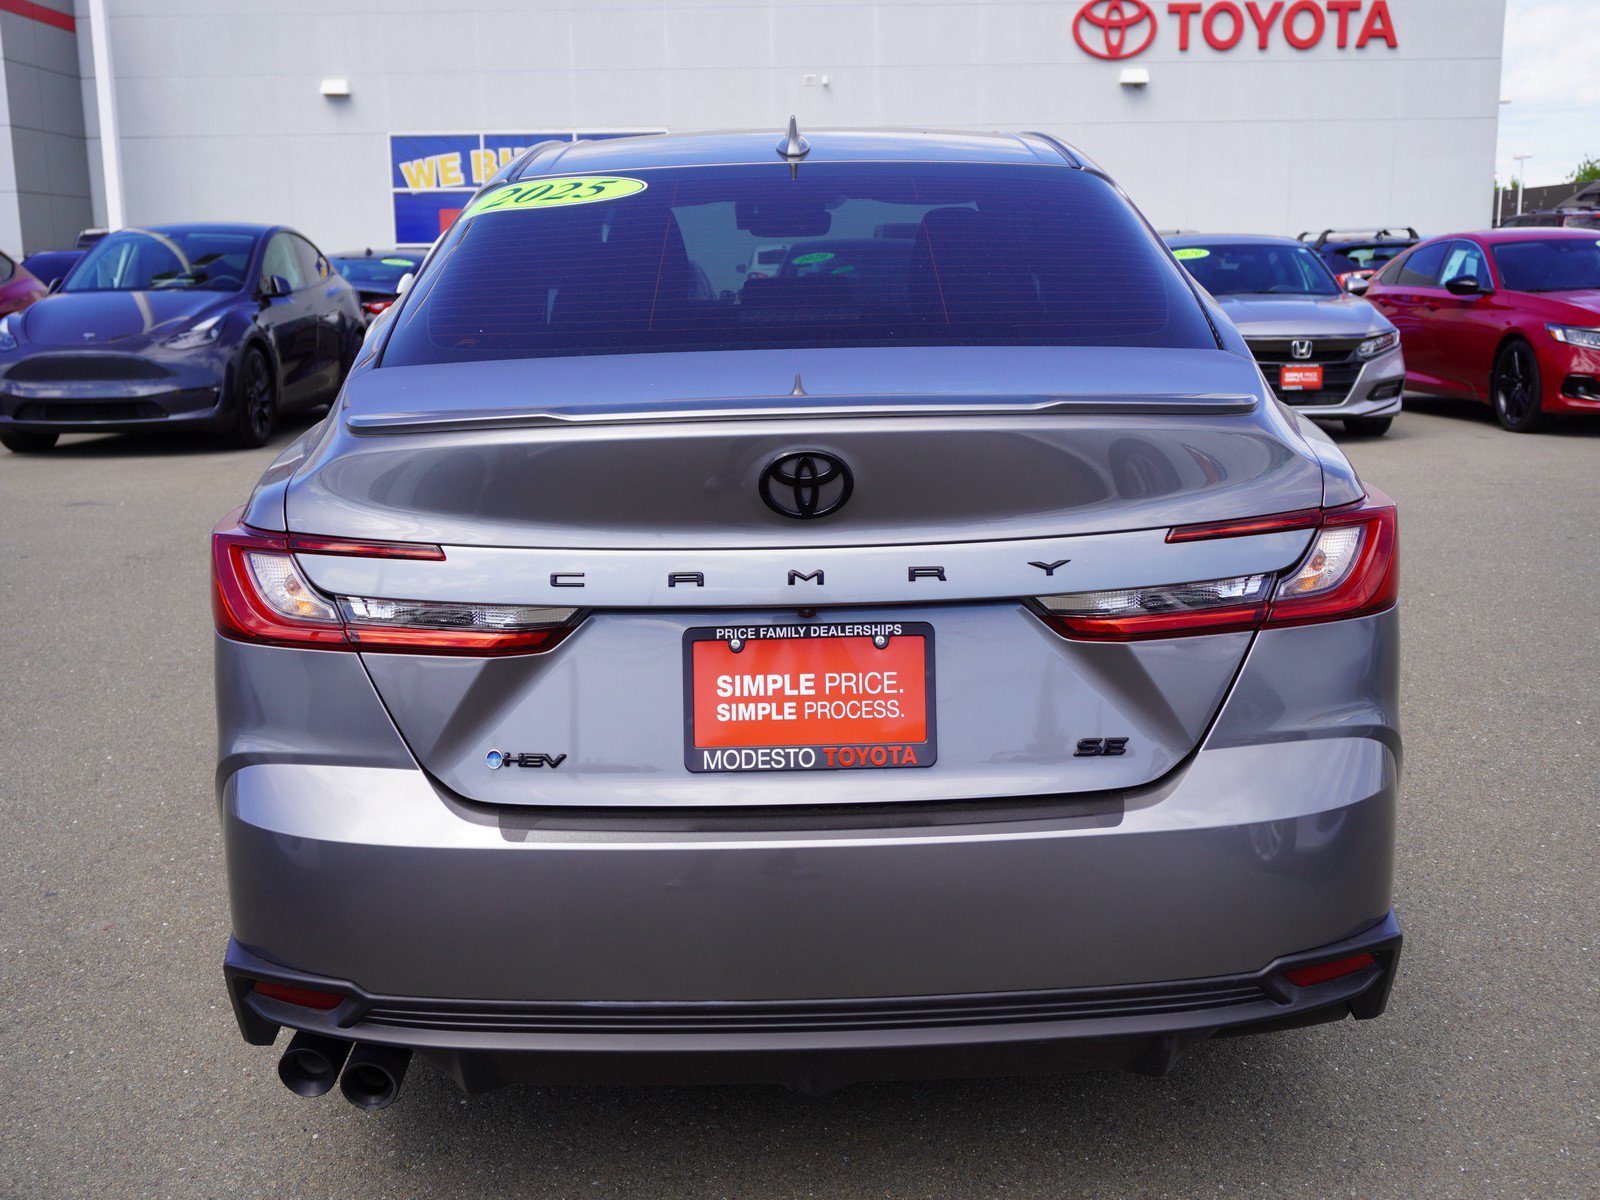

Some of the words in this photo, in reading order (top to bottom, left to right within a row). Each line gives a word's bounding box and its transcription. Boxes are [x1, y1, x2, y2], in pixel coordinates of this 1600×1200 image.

[1168, 1, 1398, 51] TOYOTA
[399, 152, 465, 194] WE
[480, 180, 620, 211] 2025
[549, 559, 1071, 588] CAMRY
[716, 628, 756, 639] PRICE
[760, 626, 806, 638] FAMILY
[810, 624, 902, 638] DEALERSHIPS
[716, 673, 816, 697] SIMPLE
[825, 672, 904, 695] PRICE.
[716, 702, 797, 722] SIMPLE
[804, 700, 905, 720] PROCESS.
[703, 747, 816, 770] MODESTO
[823, 746, 918, 768] TOYOTA
[1073, 737, 1130, 757] SE
